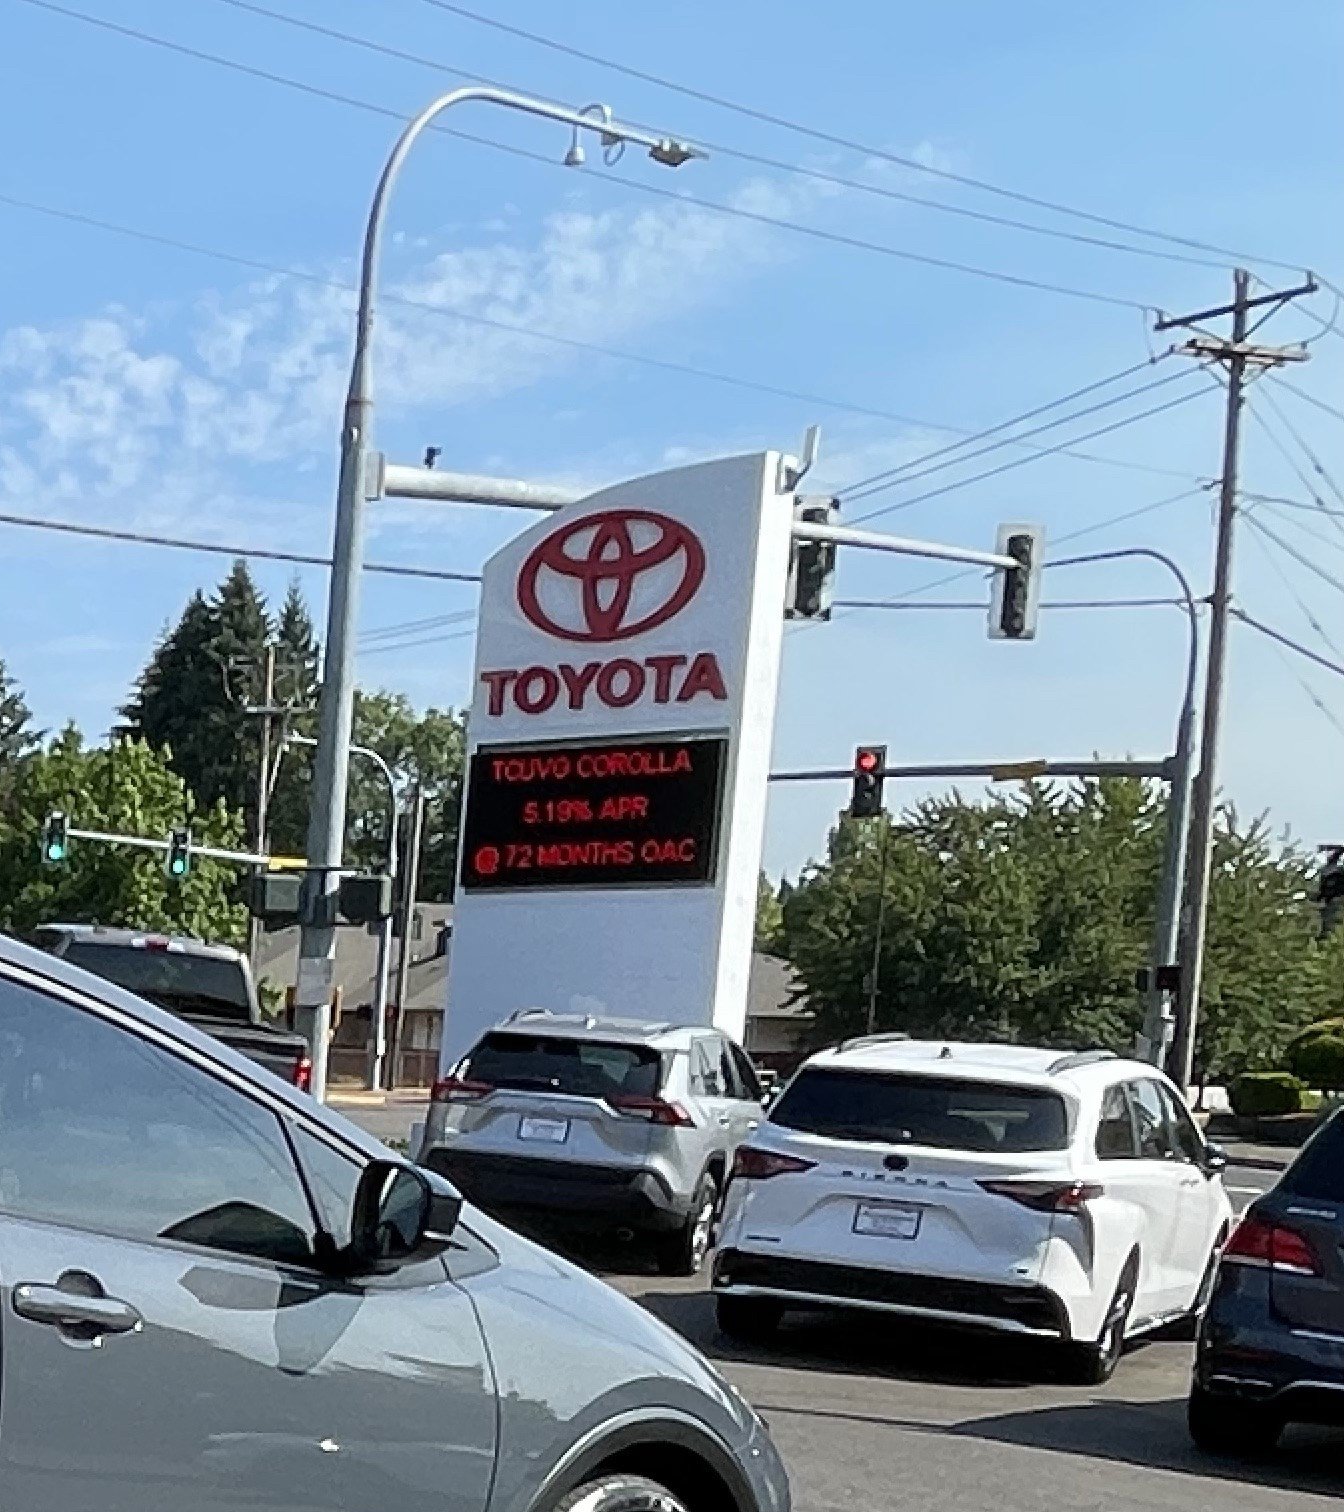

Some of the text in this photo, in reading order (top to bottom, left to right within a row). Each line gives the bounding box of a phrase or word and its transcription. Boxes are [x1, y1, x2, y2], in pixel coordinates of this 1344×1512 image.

[480, 652, 728, 716] TOYOTA
[576, 749, 693, 778] COROLLA
[599, 796, 649, 820] APR
[505, 844, 532, 868] 72
[536, 841, 634, 866] MONTHS
[640, 838, 696, 863] OAC
